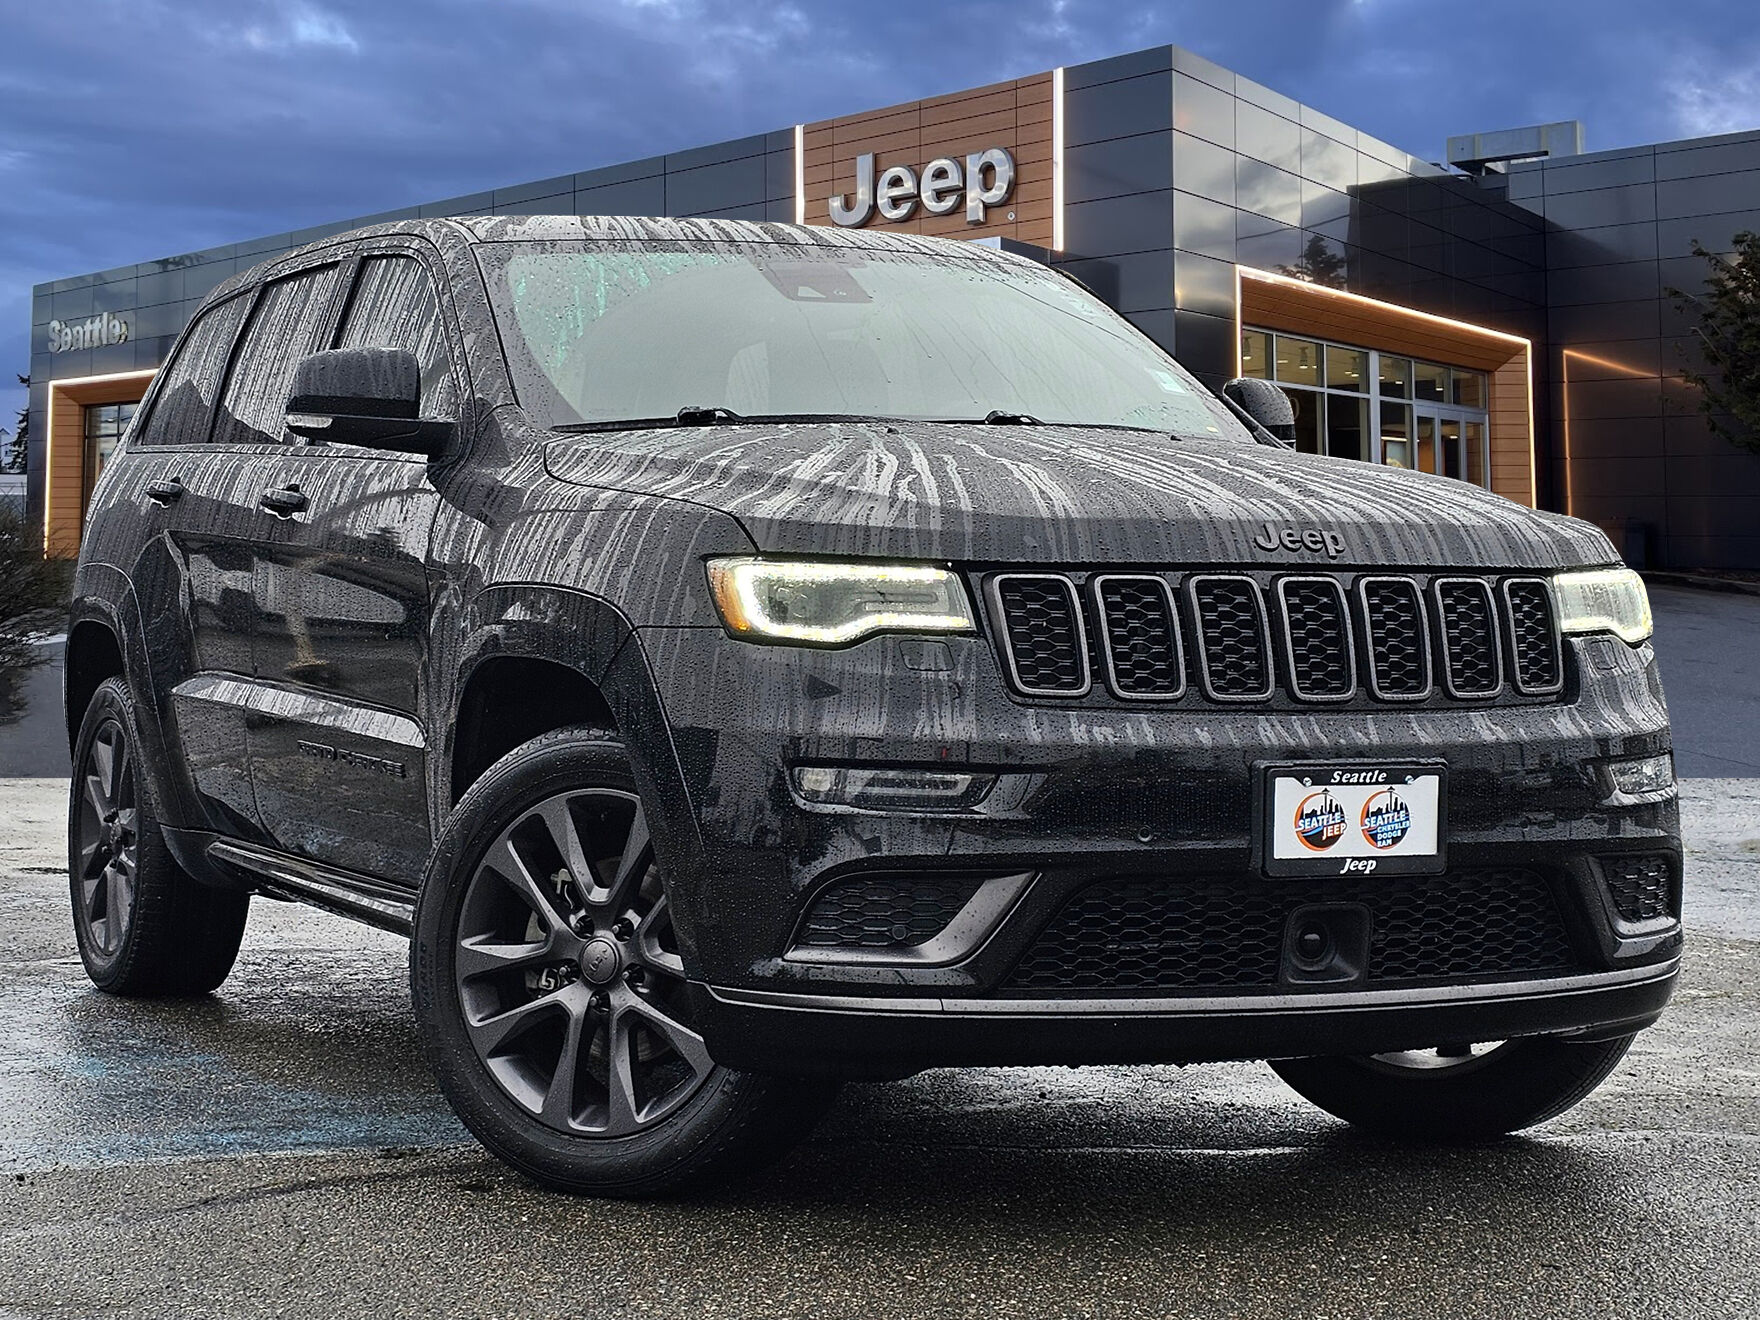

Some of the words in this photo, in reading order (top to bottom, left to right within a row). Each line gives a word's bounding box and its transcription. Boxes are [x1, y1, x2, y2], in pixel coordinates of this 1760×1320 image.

[829, 147, 1016, 228] Jeep
[48, 311, 127, 353] Seattle
[1254, 522, 1346, 560] Jeep
[1330, 770, 1388, 784] Seattle
[1297, 811, 1342, 830] SEATTLE
[1365, 810, 1406, 828] SEATTLE
[1322, 822, 1347, 840] JEEP
[1377, 830, 1402, 840] DODGE
[1376, 839, 1393, 848] RAM
[1340, 858, 1377, 874] Jeep
